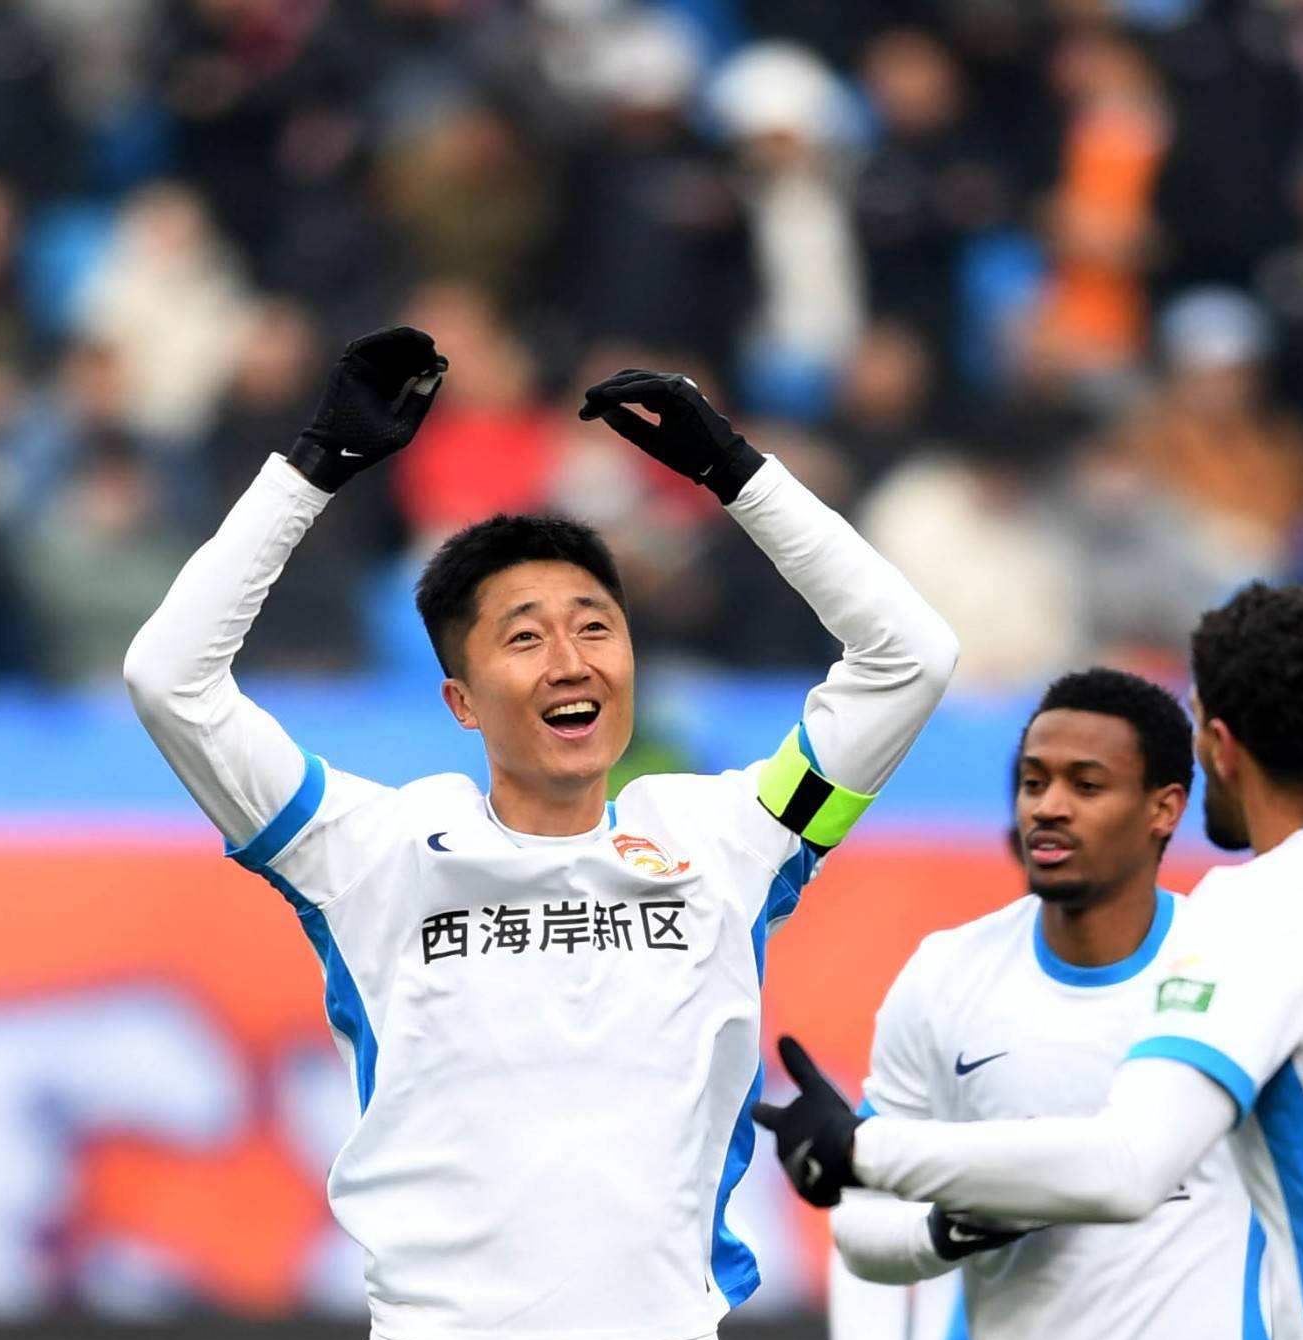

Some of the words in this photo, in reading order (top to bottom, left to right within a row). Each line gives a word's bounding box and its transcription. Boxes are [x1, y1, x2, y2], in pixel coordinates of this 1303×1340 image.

[421, 900, 689, 965] 西海岸新区
